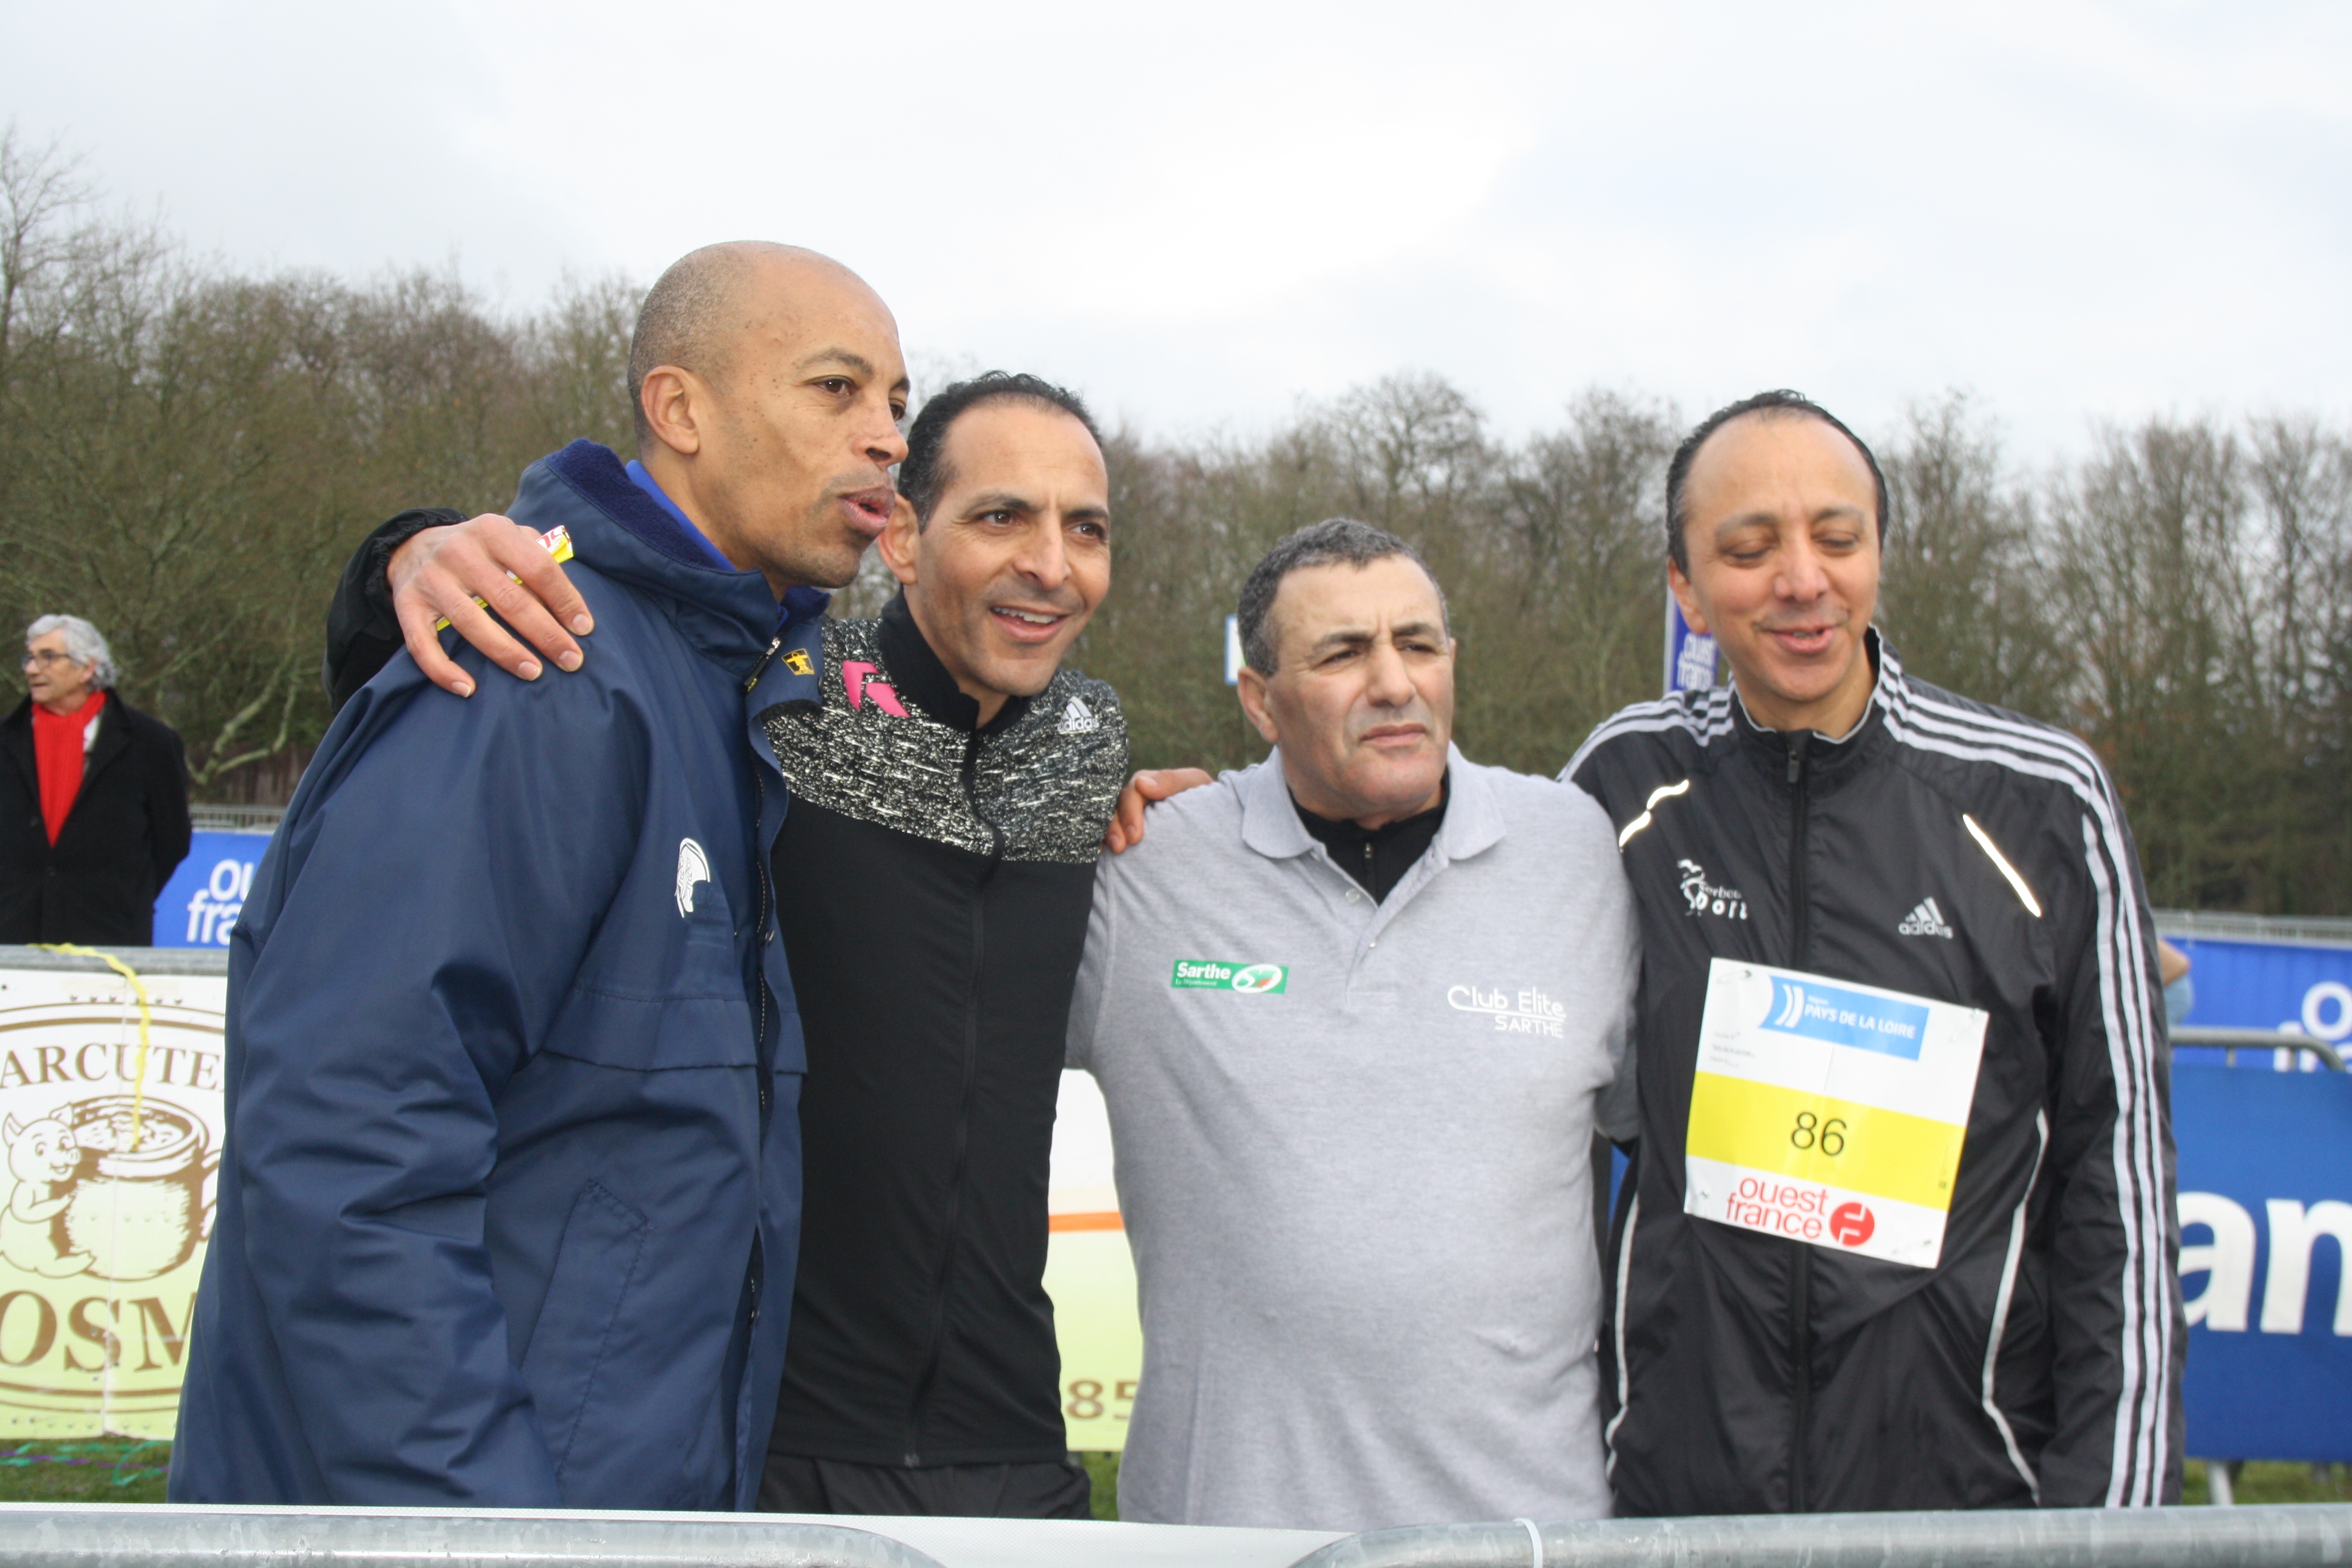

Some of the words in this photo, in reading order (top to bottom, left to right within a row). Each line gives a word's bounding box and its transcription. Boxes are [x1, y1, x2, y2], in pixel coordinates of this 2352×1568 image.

[1057, 717, 1100, 734] adidas
[1898, 920, 1953, 939] adidas
[1177, 961, 1231, 980] Sarthe
[1447, 985, 1509, 1010] Club
[1518, 985, 1566, 1018] Elite
[1494, 1014, 1564, 1039] SARTHE
[1805, 1004, 1837, 1022] PAYS
[1839, 1011, 1857, 1027] DE
[1859, 1014, 1875, 1030] LA
[1878, 1019, 1915, 1039] LOIRE
[0, 1043, 224, 1091] ARCUTE
[1791, 1111, 1847, 1157] 86
[1739, 1177, 1829, 1217] ouest
[1725, 1192, 1822, 1240] france
[1067, 1379, 1138, 1420] 85
